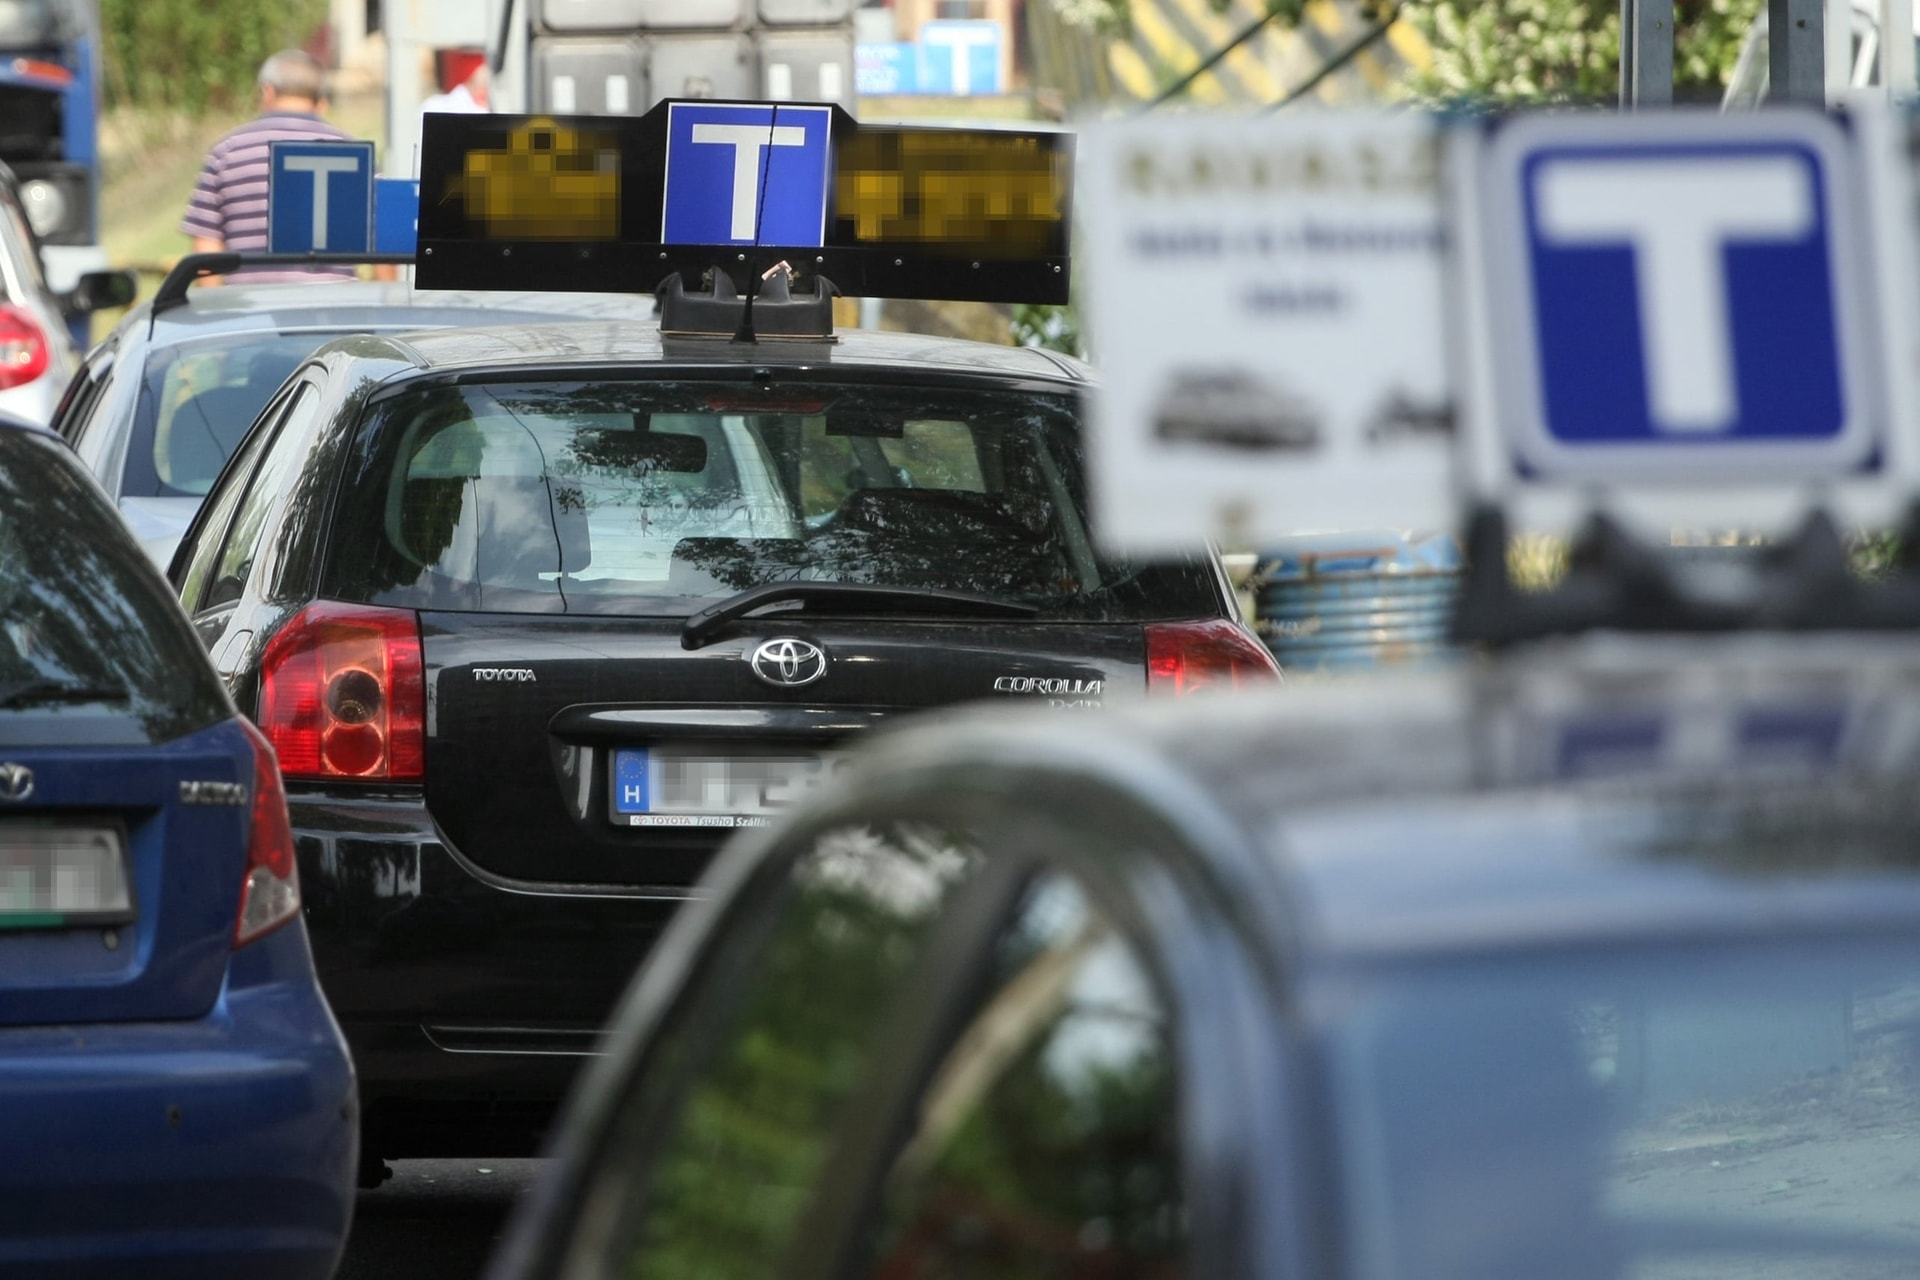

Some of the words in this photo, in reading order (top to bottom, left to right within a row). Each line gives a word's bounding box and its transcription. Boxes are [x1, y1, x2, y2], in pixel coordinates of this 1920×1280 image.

[692, 123, 806, 240] T
[283, 155, 359, 249] T
[1536, 156, 1818, 434] T
[472, 668, 537, 682] TOYOTA
[993, 676, 1102, 696] COROLLA
[624, 784, 640, 803] H
[650, 816, 691, 826] TOYOTA
[696, 816, 731, 827] Tsusho
